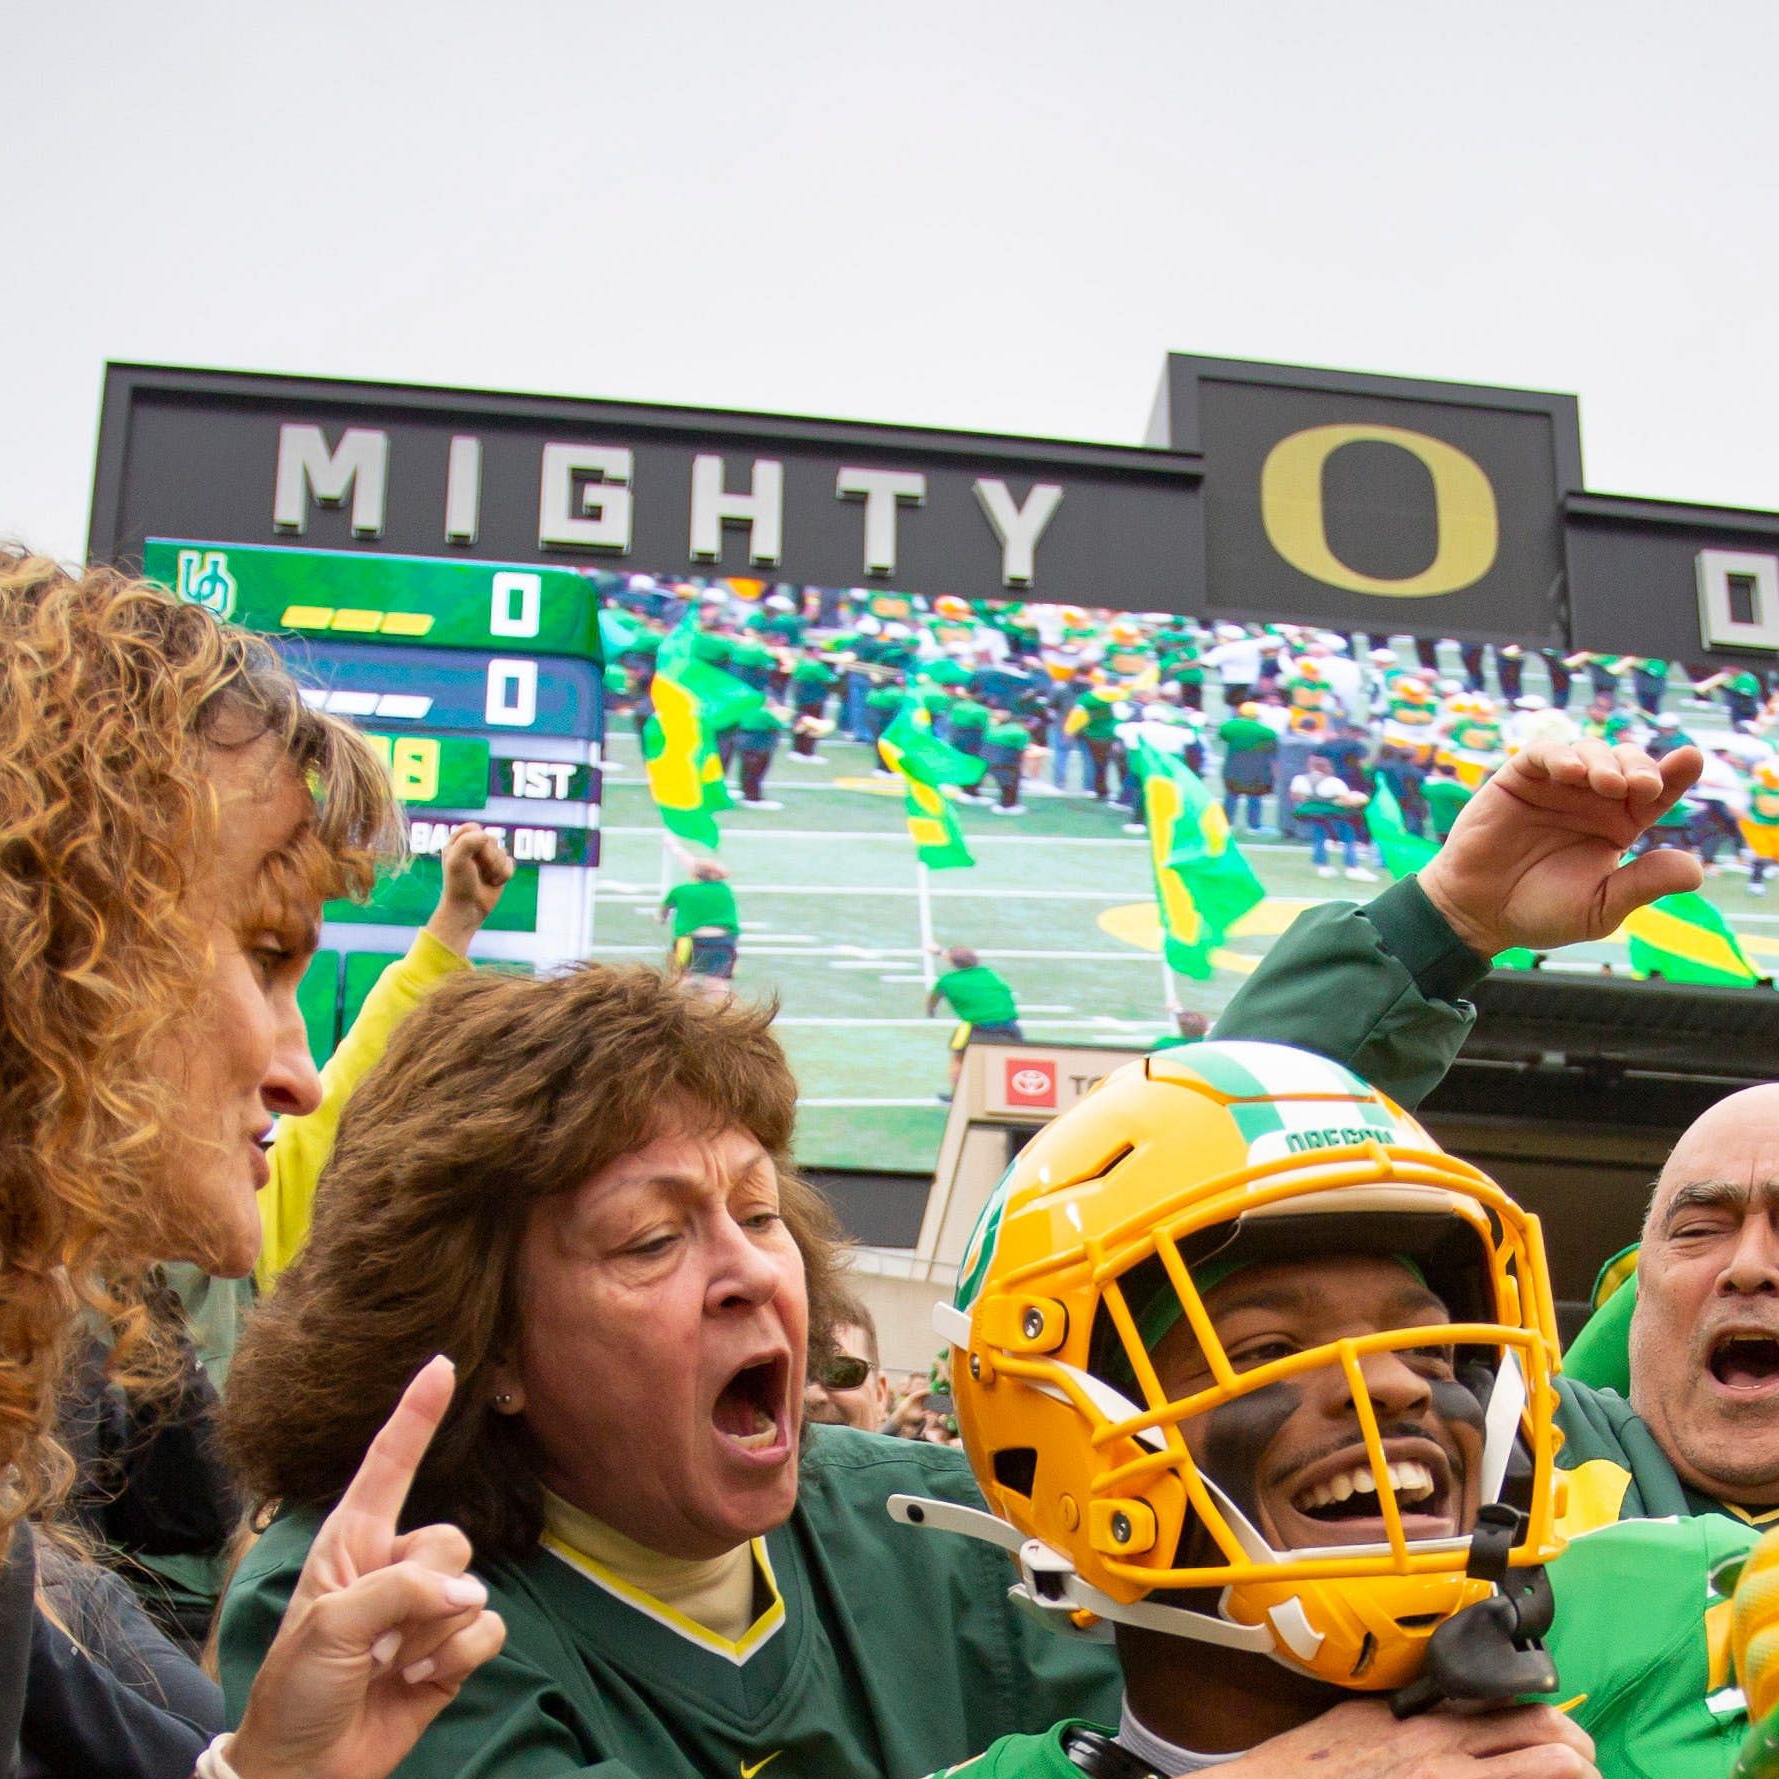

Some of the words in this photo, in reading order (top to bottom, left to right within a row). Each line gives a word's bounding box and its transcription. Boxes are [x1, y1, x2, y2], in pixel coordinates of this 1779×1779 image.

[272, 423, 1064, 588] MIGHTY
[1259, 423, 1501, 598] O
[489, 571, 541, 638] 0
[484, 658, 538, 727] 0
[510, 760, 577, 800] 1ST
[513, 827, 558, 862] ON
